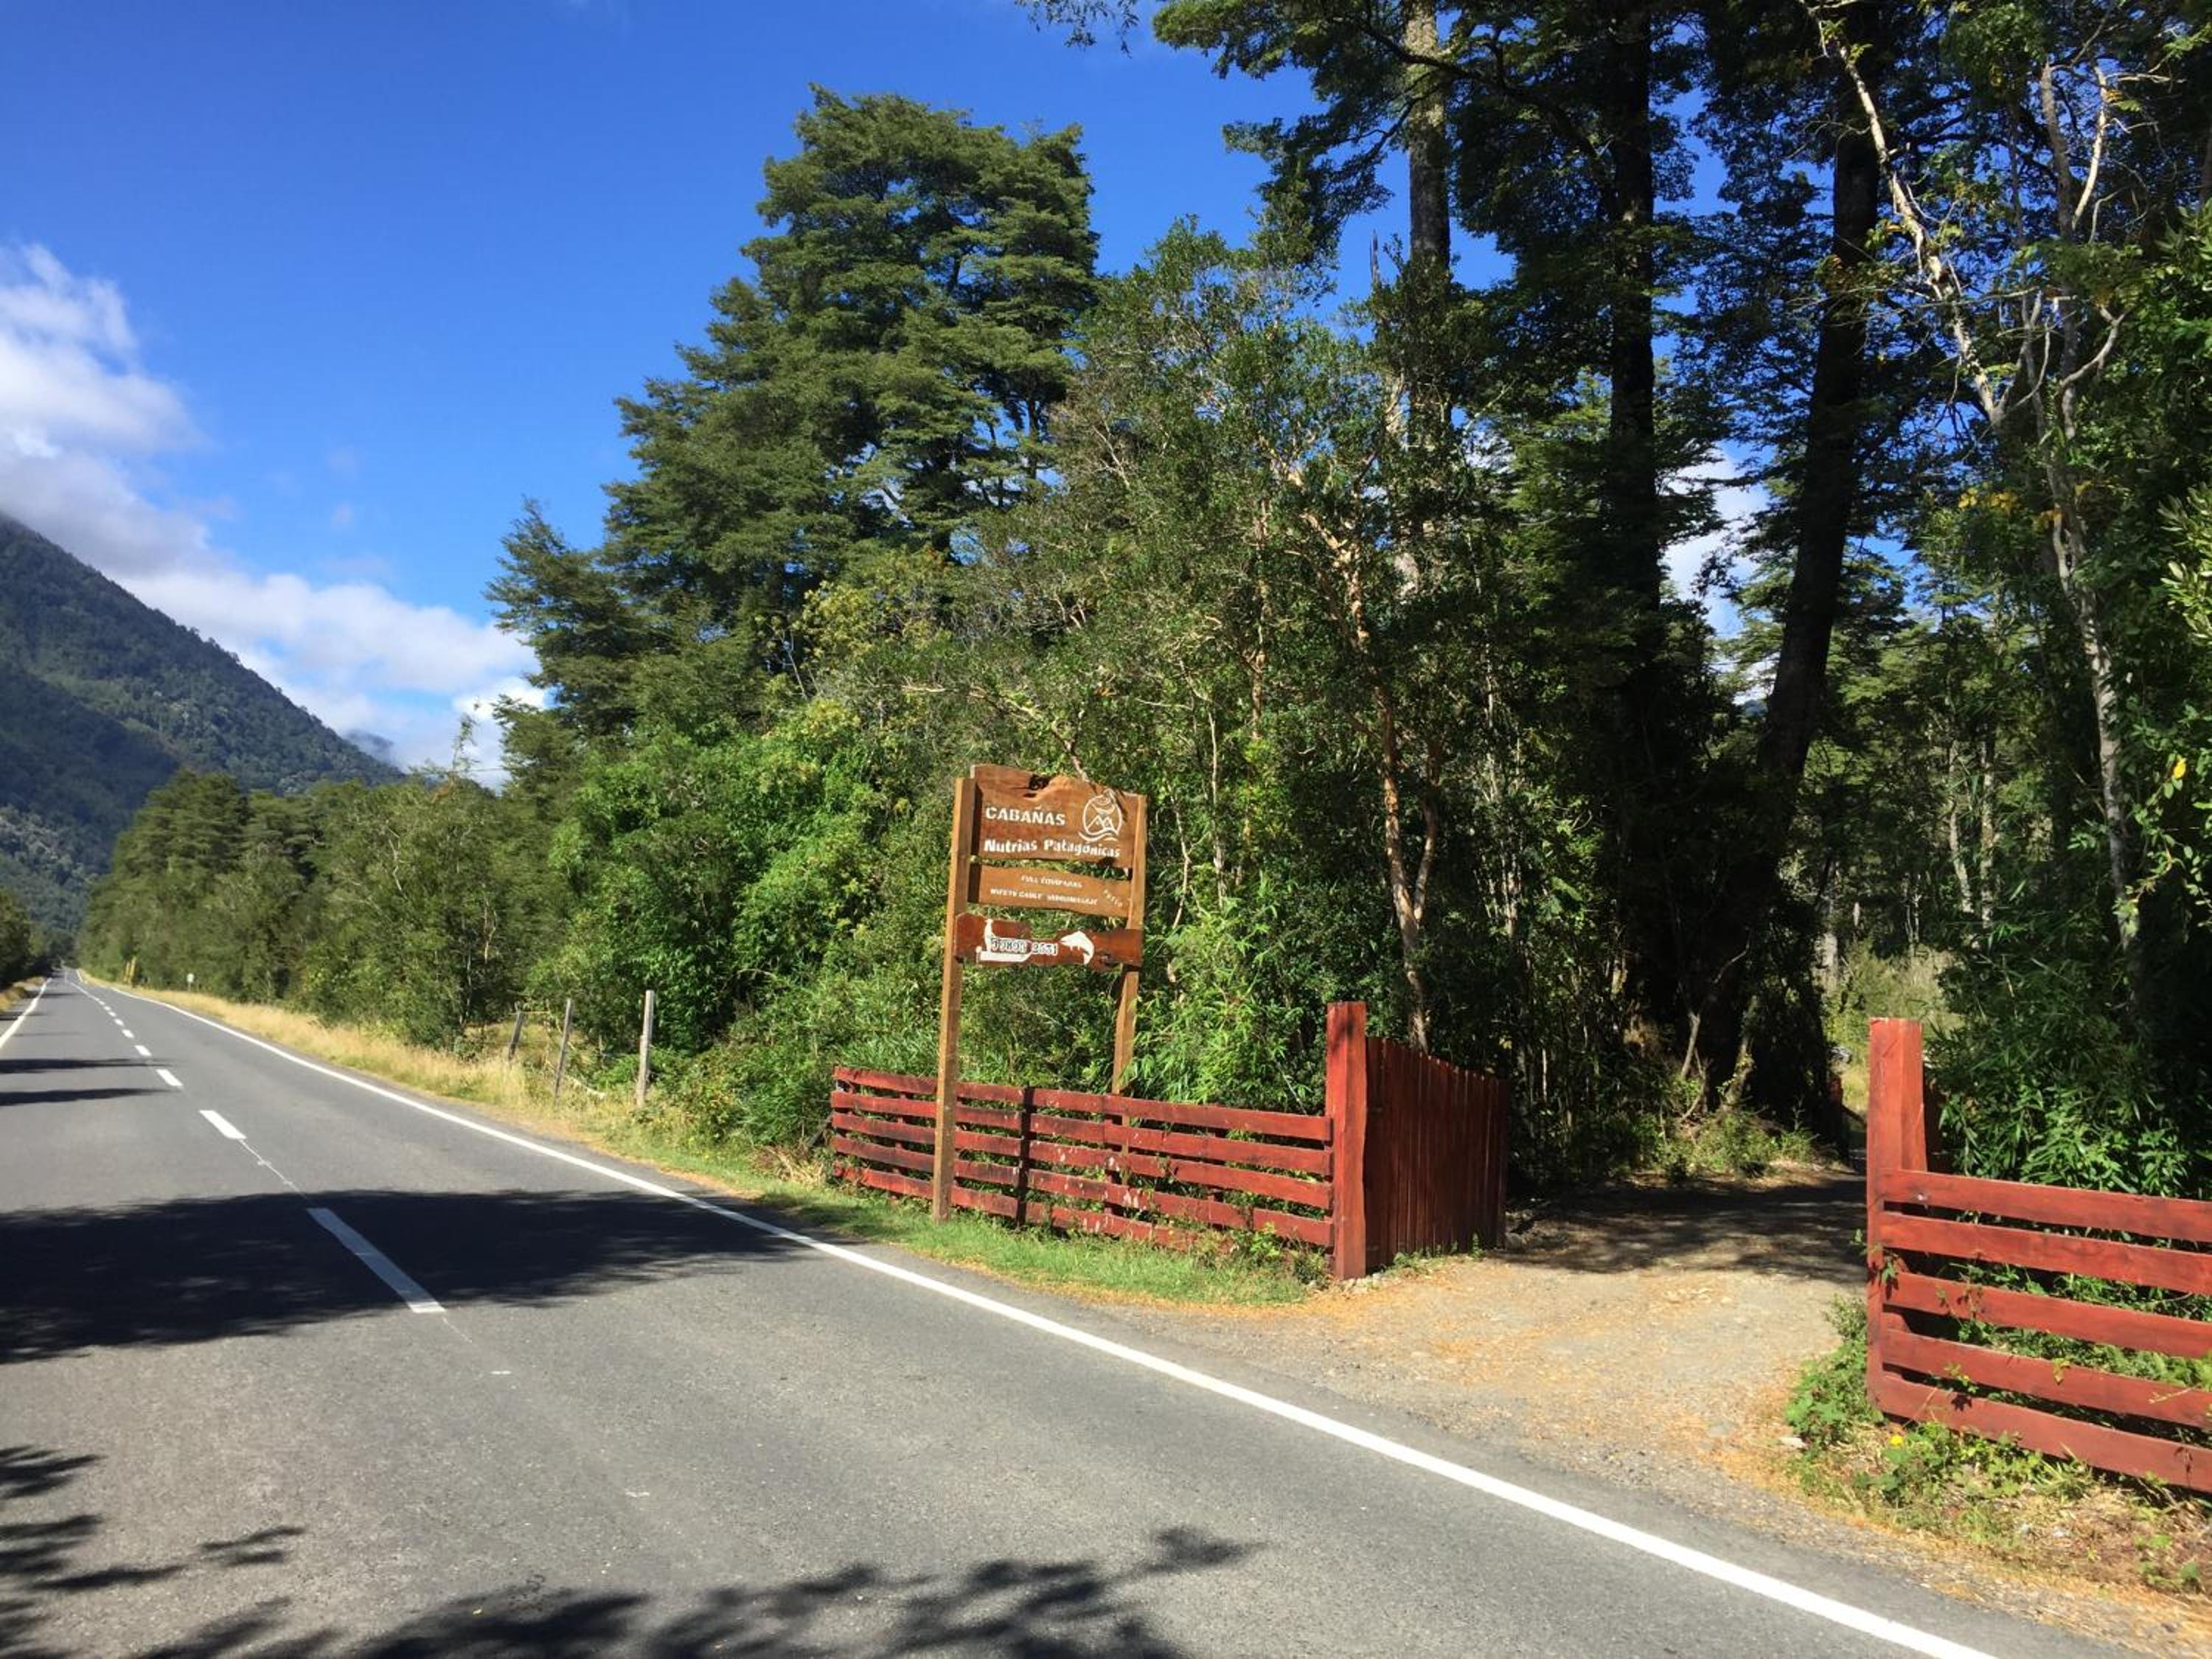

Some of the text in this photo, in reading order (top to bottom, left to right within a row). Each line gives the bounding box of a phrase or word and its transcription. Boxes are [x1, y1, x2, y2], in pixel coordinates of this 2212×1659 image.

[985, 804, 1066, 827] CABAÑAS
[984, 838, 1121, 858] Nutrias Patagónicas
